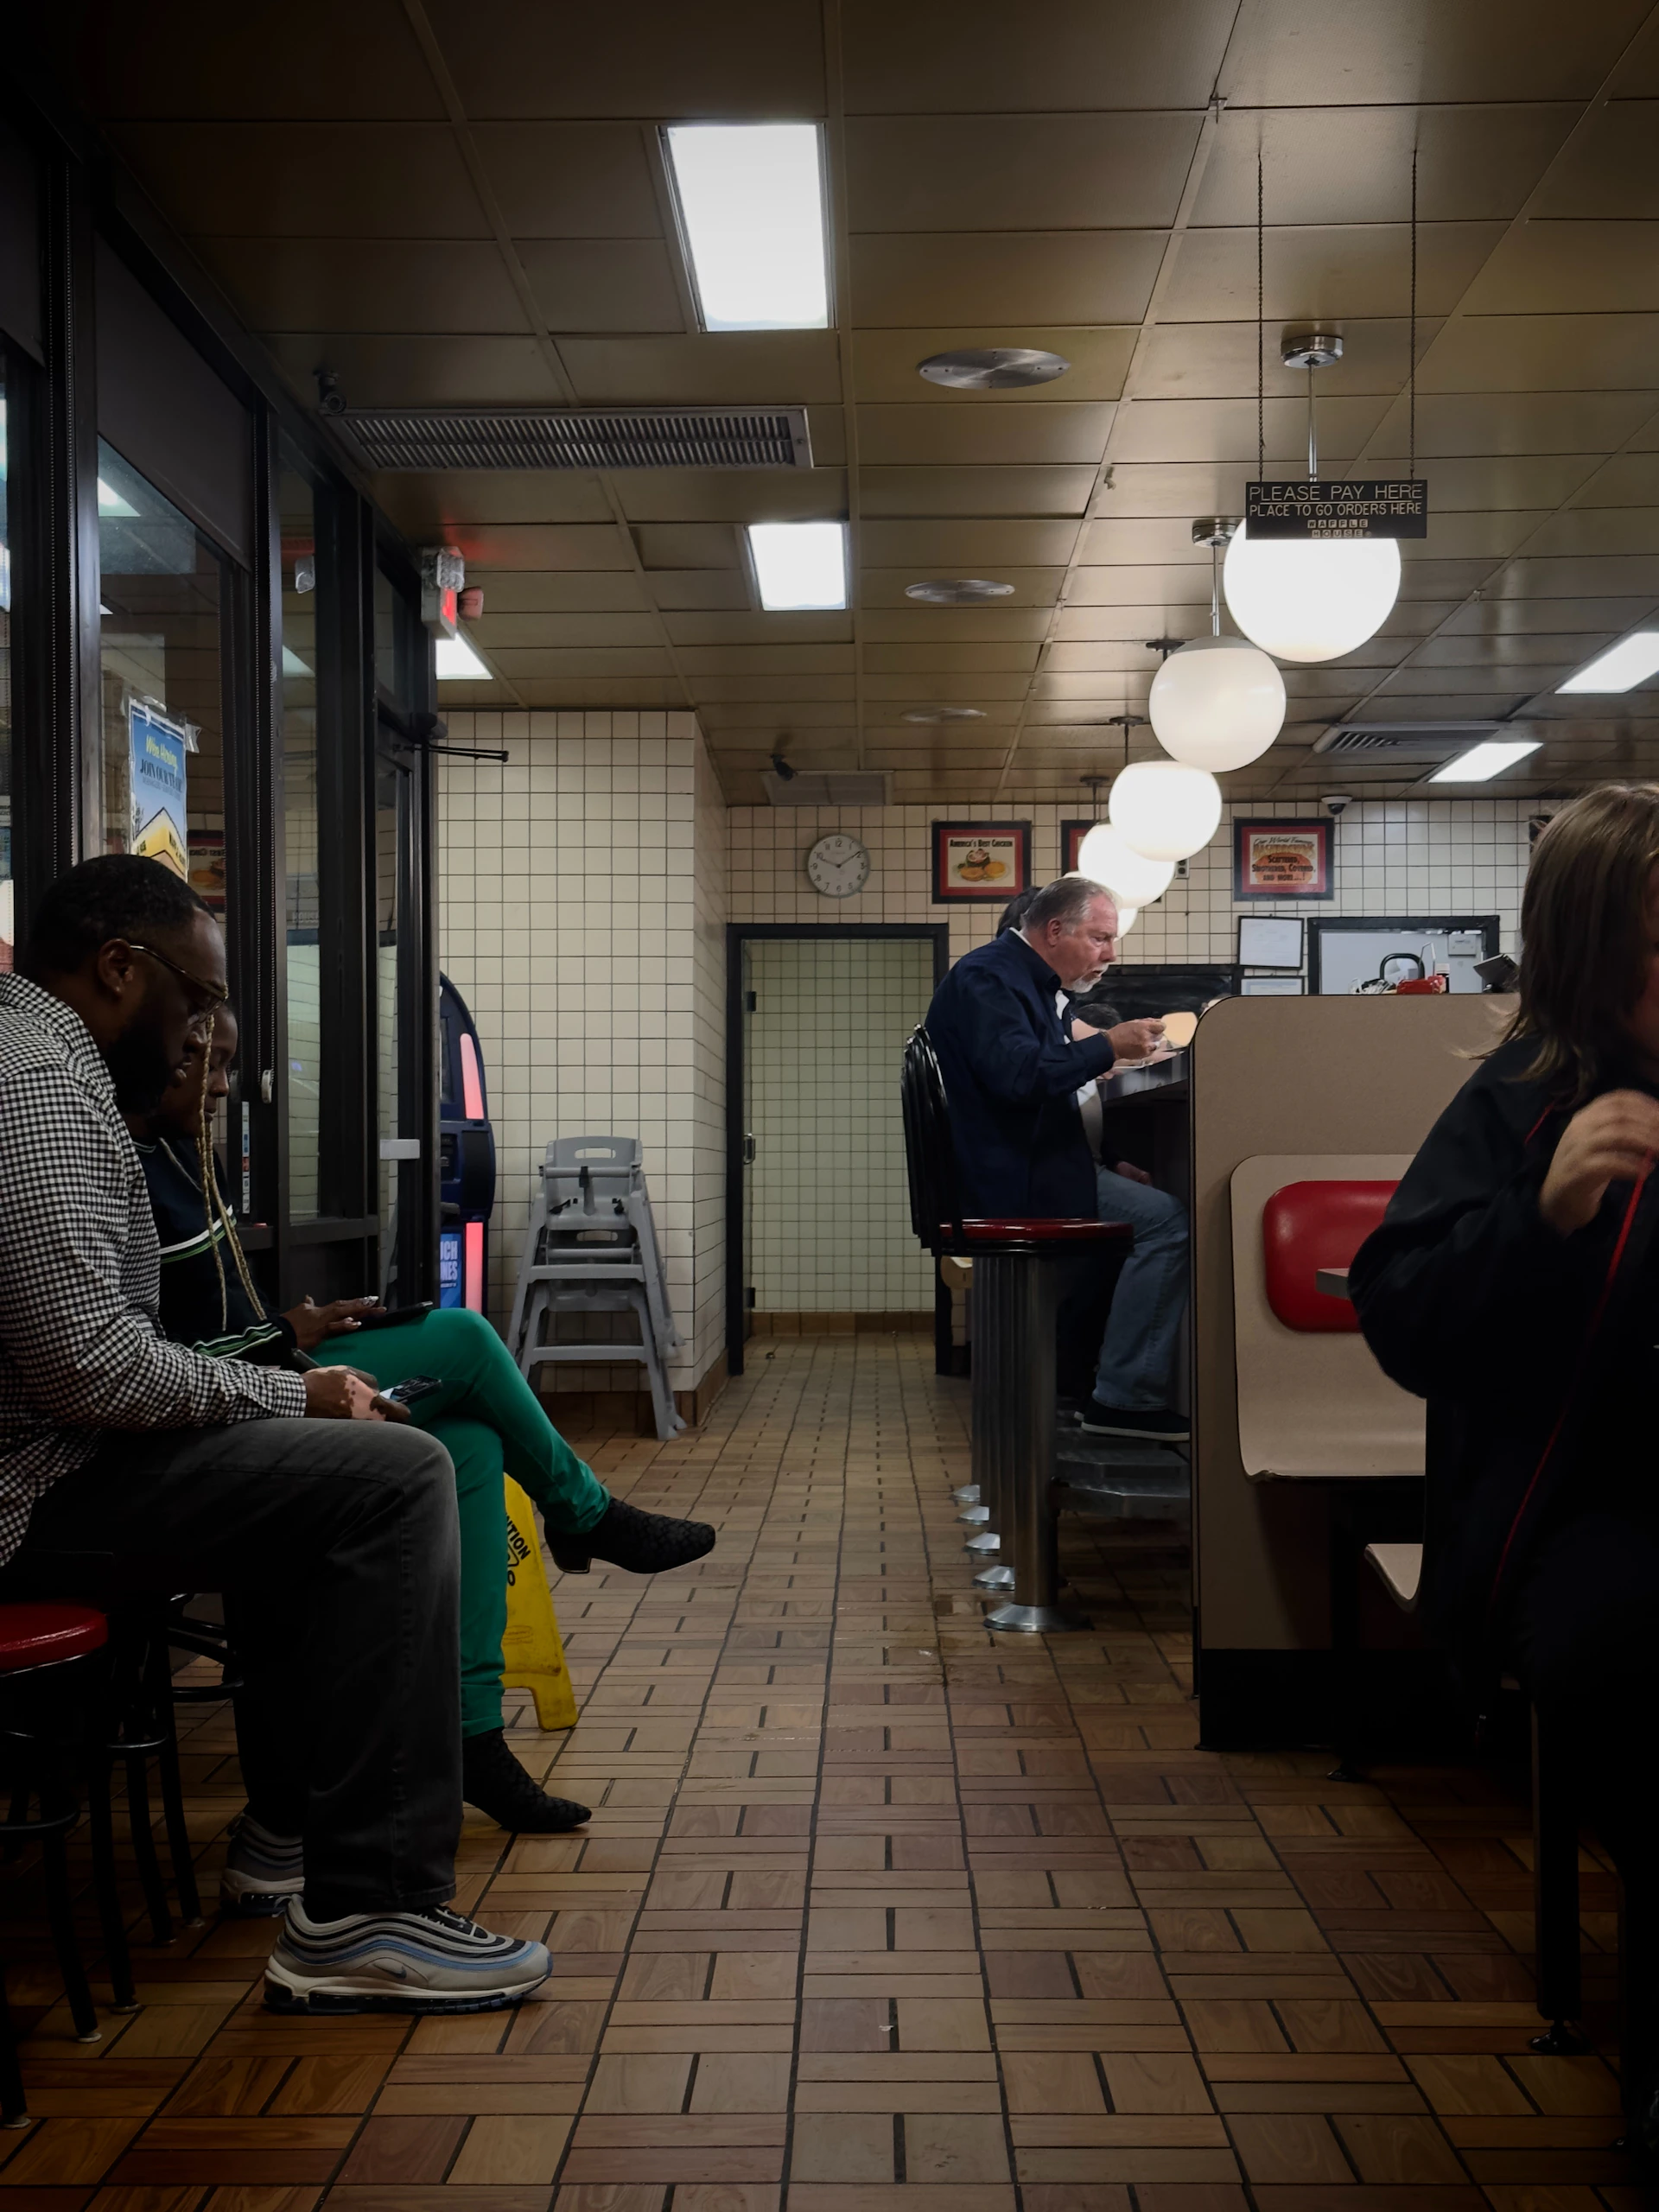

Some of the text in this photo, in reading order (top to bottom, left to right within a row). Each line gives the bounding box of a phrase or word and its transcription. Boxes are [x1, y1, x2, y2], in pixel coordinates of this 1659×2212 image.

[1249, 483, 1423, 501] PLEASE PAY HERE
[1249, 502, 1422, 517] PLACE TO GO ORDERS HERE
[1307, 518, 1369, 529] WAFFLE
[1312, 529, 1363, 538] HOUSE
